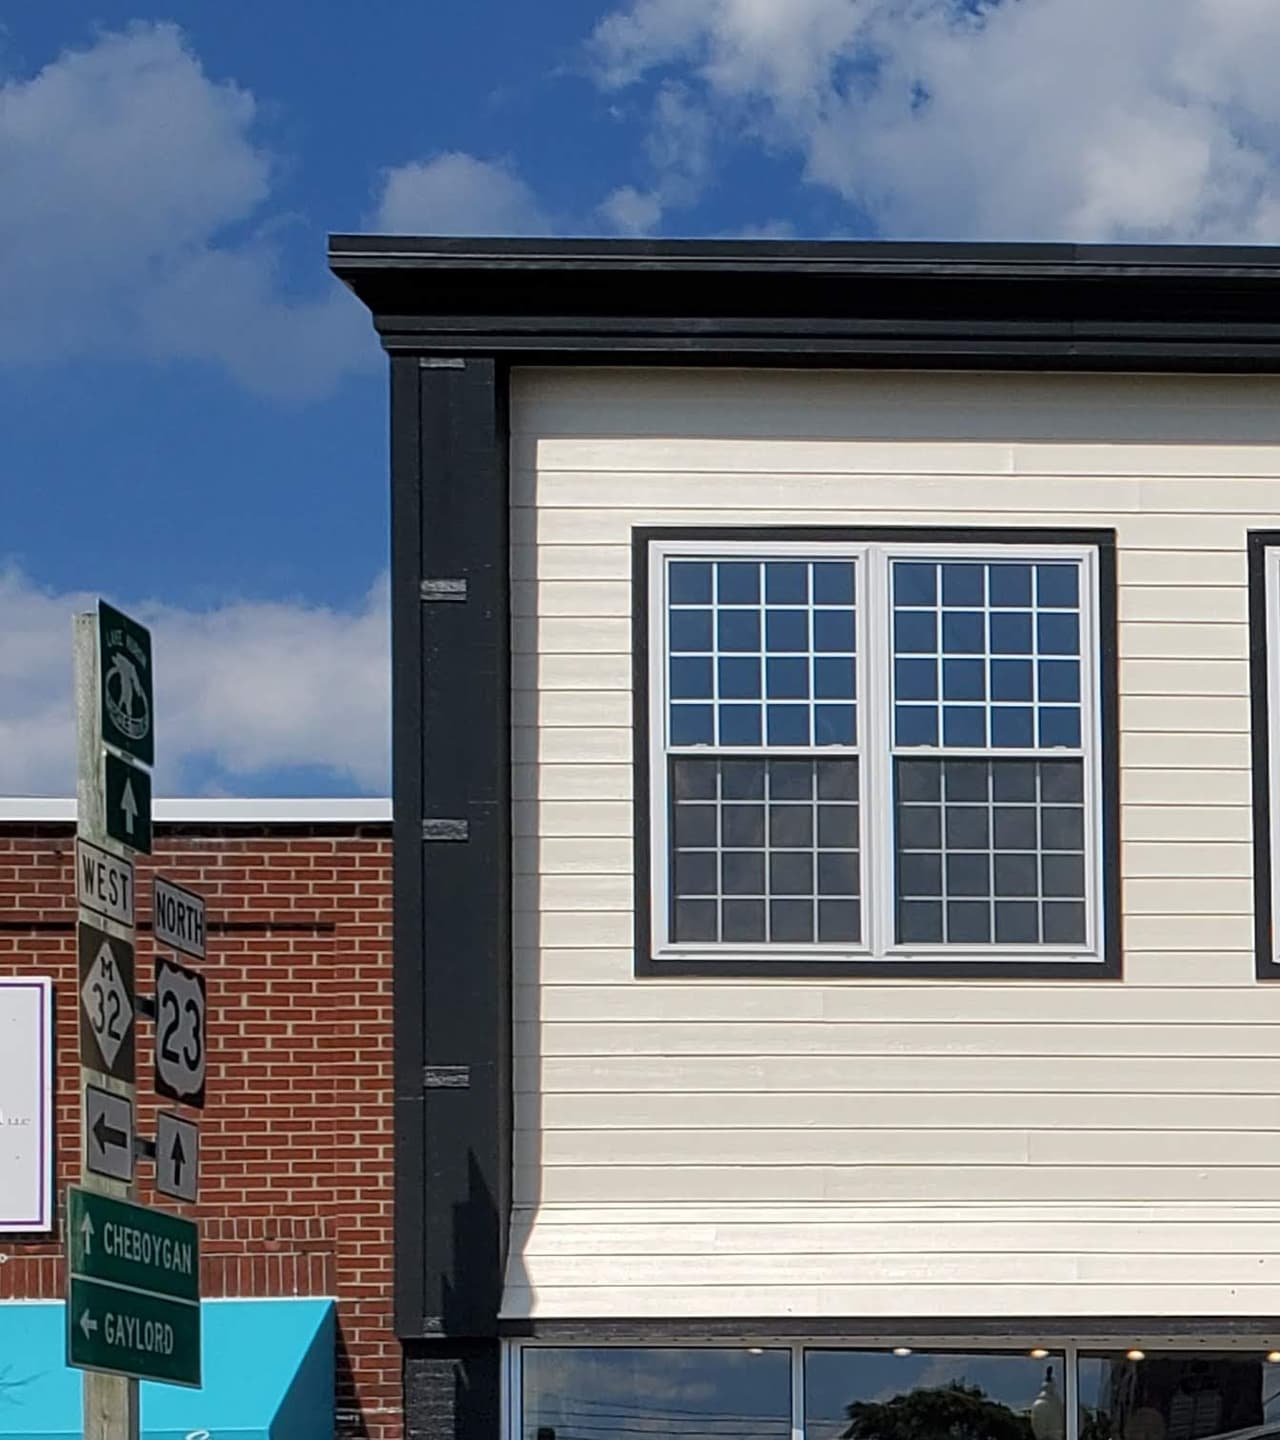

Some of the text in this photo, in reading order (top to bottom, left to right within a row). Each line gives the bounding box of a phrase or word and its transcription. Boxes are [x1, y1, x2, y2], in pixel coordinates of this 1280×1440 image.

[82, 854, 128, 911] WEST
[156, 891, 203, 945] NORTH
[101, 957, 113, 982] M
[93, 983, 121, 1041] 32
[162, 990, 201, 1071] 23
[104, 1222, 192, 1275] CHEBOYGAN
[105, 1312, 174, 1355] GAYLORD
